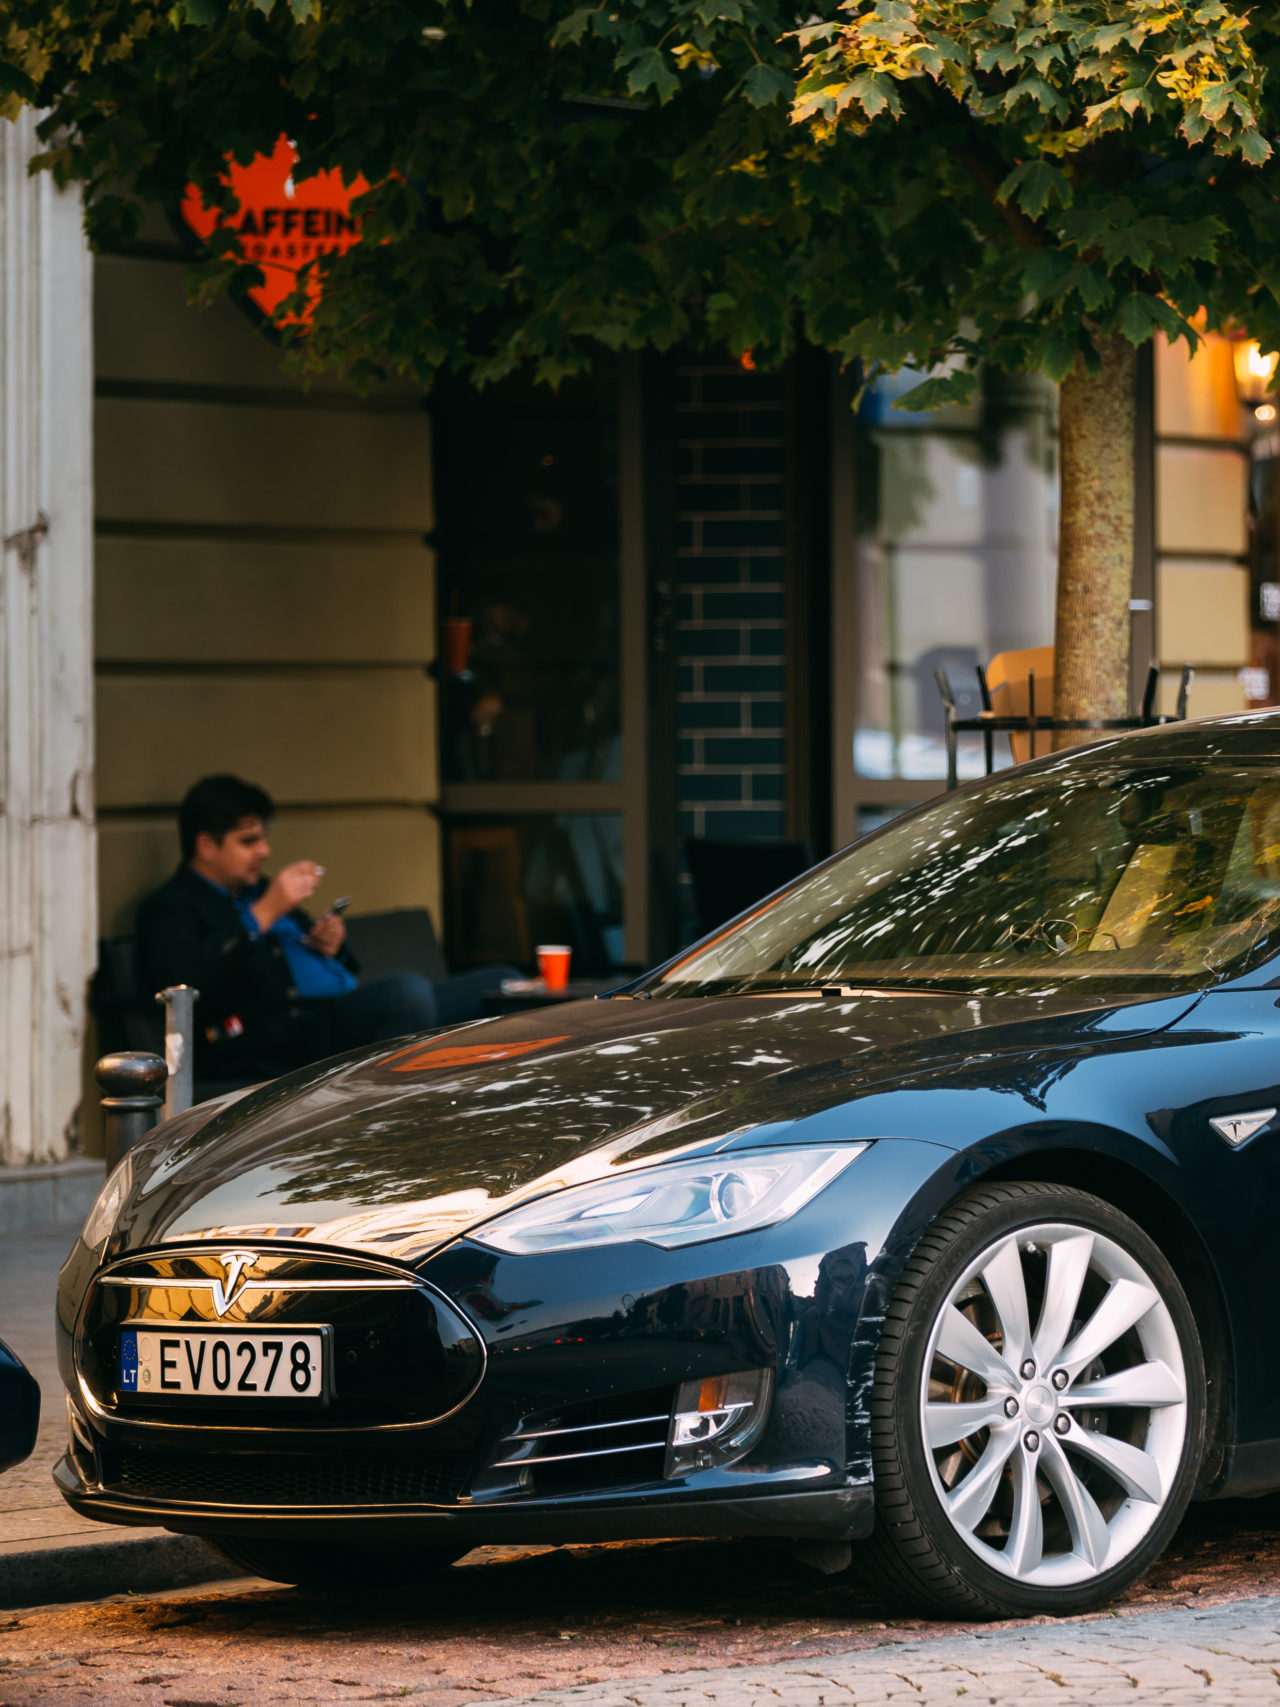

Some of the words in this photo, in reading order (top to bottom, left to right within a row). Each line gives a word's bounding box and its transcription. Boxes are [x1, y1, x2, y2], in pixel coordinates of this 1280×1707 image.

[214, 207, 364, 238] AFFEIN
[123, 1369, 137, 1384] LT
[159, 1338, 312, 1393] EV0278
